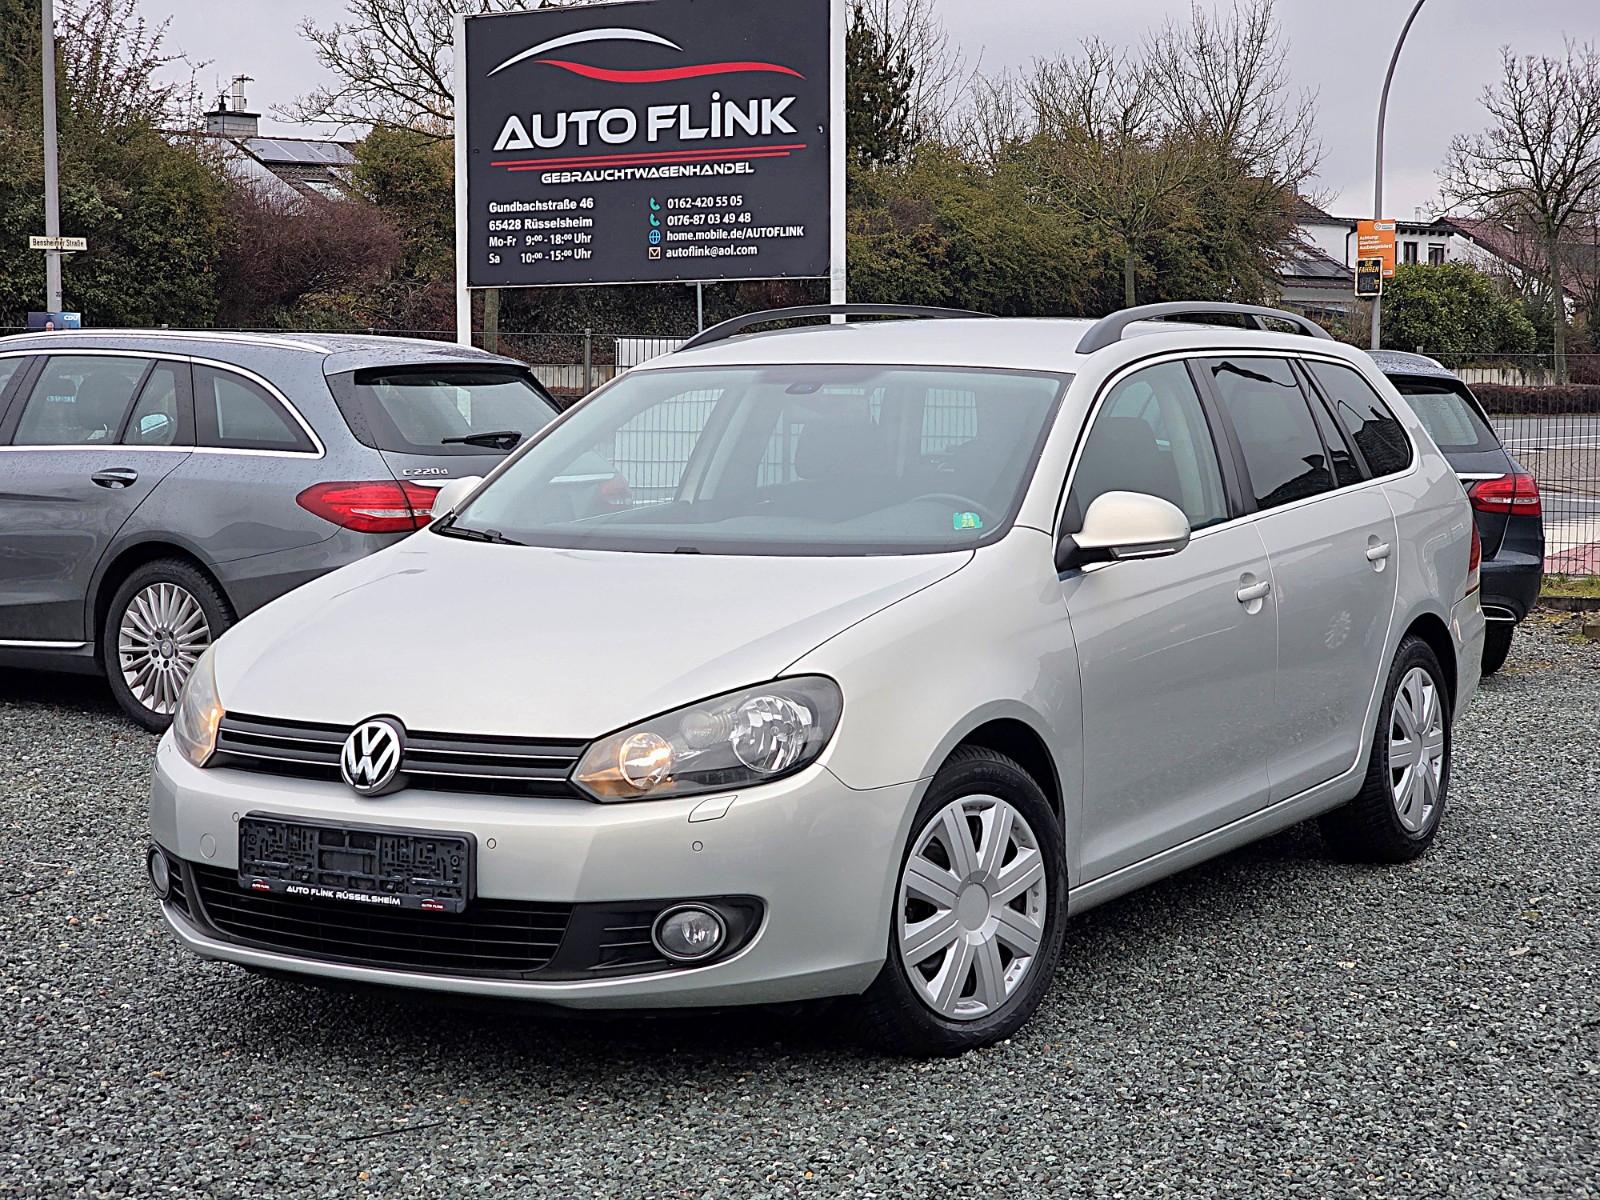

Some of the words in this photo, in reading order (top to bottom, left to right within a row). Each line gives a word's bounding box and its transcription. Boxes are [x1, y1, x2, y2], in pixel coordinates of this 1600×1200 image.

[493, 108, 637, 151] AUTO
[541, 162, 755, 184] GEBRAUCHTWAGENHANDEL
[489, 199, 577, 213] Gundbachstraße
[579, 197, 594, 209] 46
[667, 196, 714, 209] 0162-420
[715, 196, 728, 207] 55
[730, 195, 743, 206] 05
[489, 219, 522, 231] 65428
[524, 217, 593, 230] Rüsselsheim
[667, 214, 706, 226] 0176-87
[707, 213, 721, 225] 03
[722, 213, 736, 224] 49
[738, 212, 751, 223] 48
[489, 236, 517, 247] Mo-Fr
[574, 232, 592, 244] Uhr
[666, 226, 804, 241] home.mobile.de/AUTOFLINK
[66, 239, 84, 247] Straße
[489, 253, 501, 264] Sa
[574, 248, 592, 259] Uhr
[666, 244, 758, 259] autoflink@aol.com
[286, 885, 310, 895] AUTO
